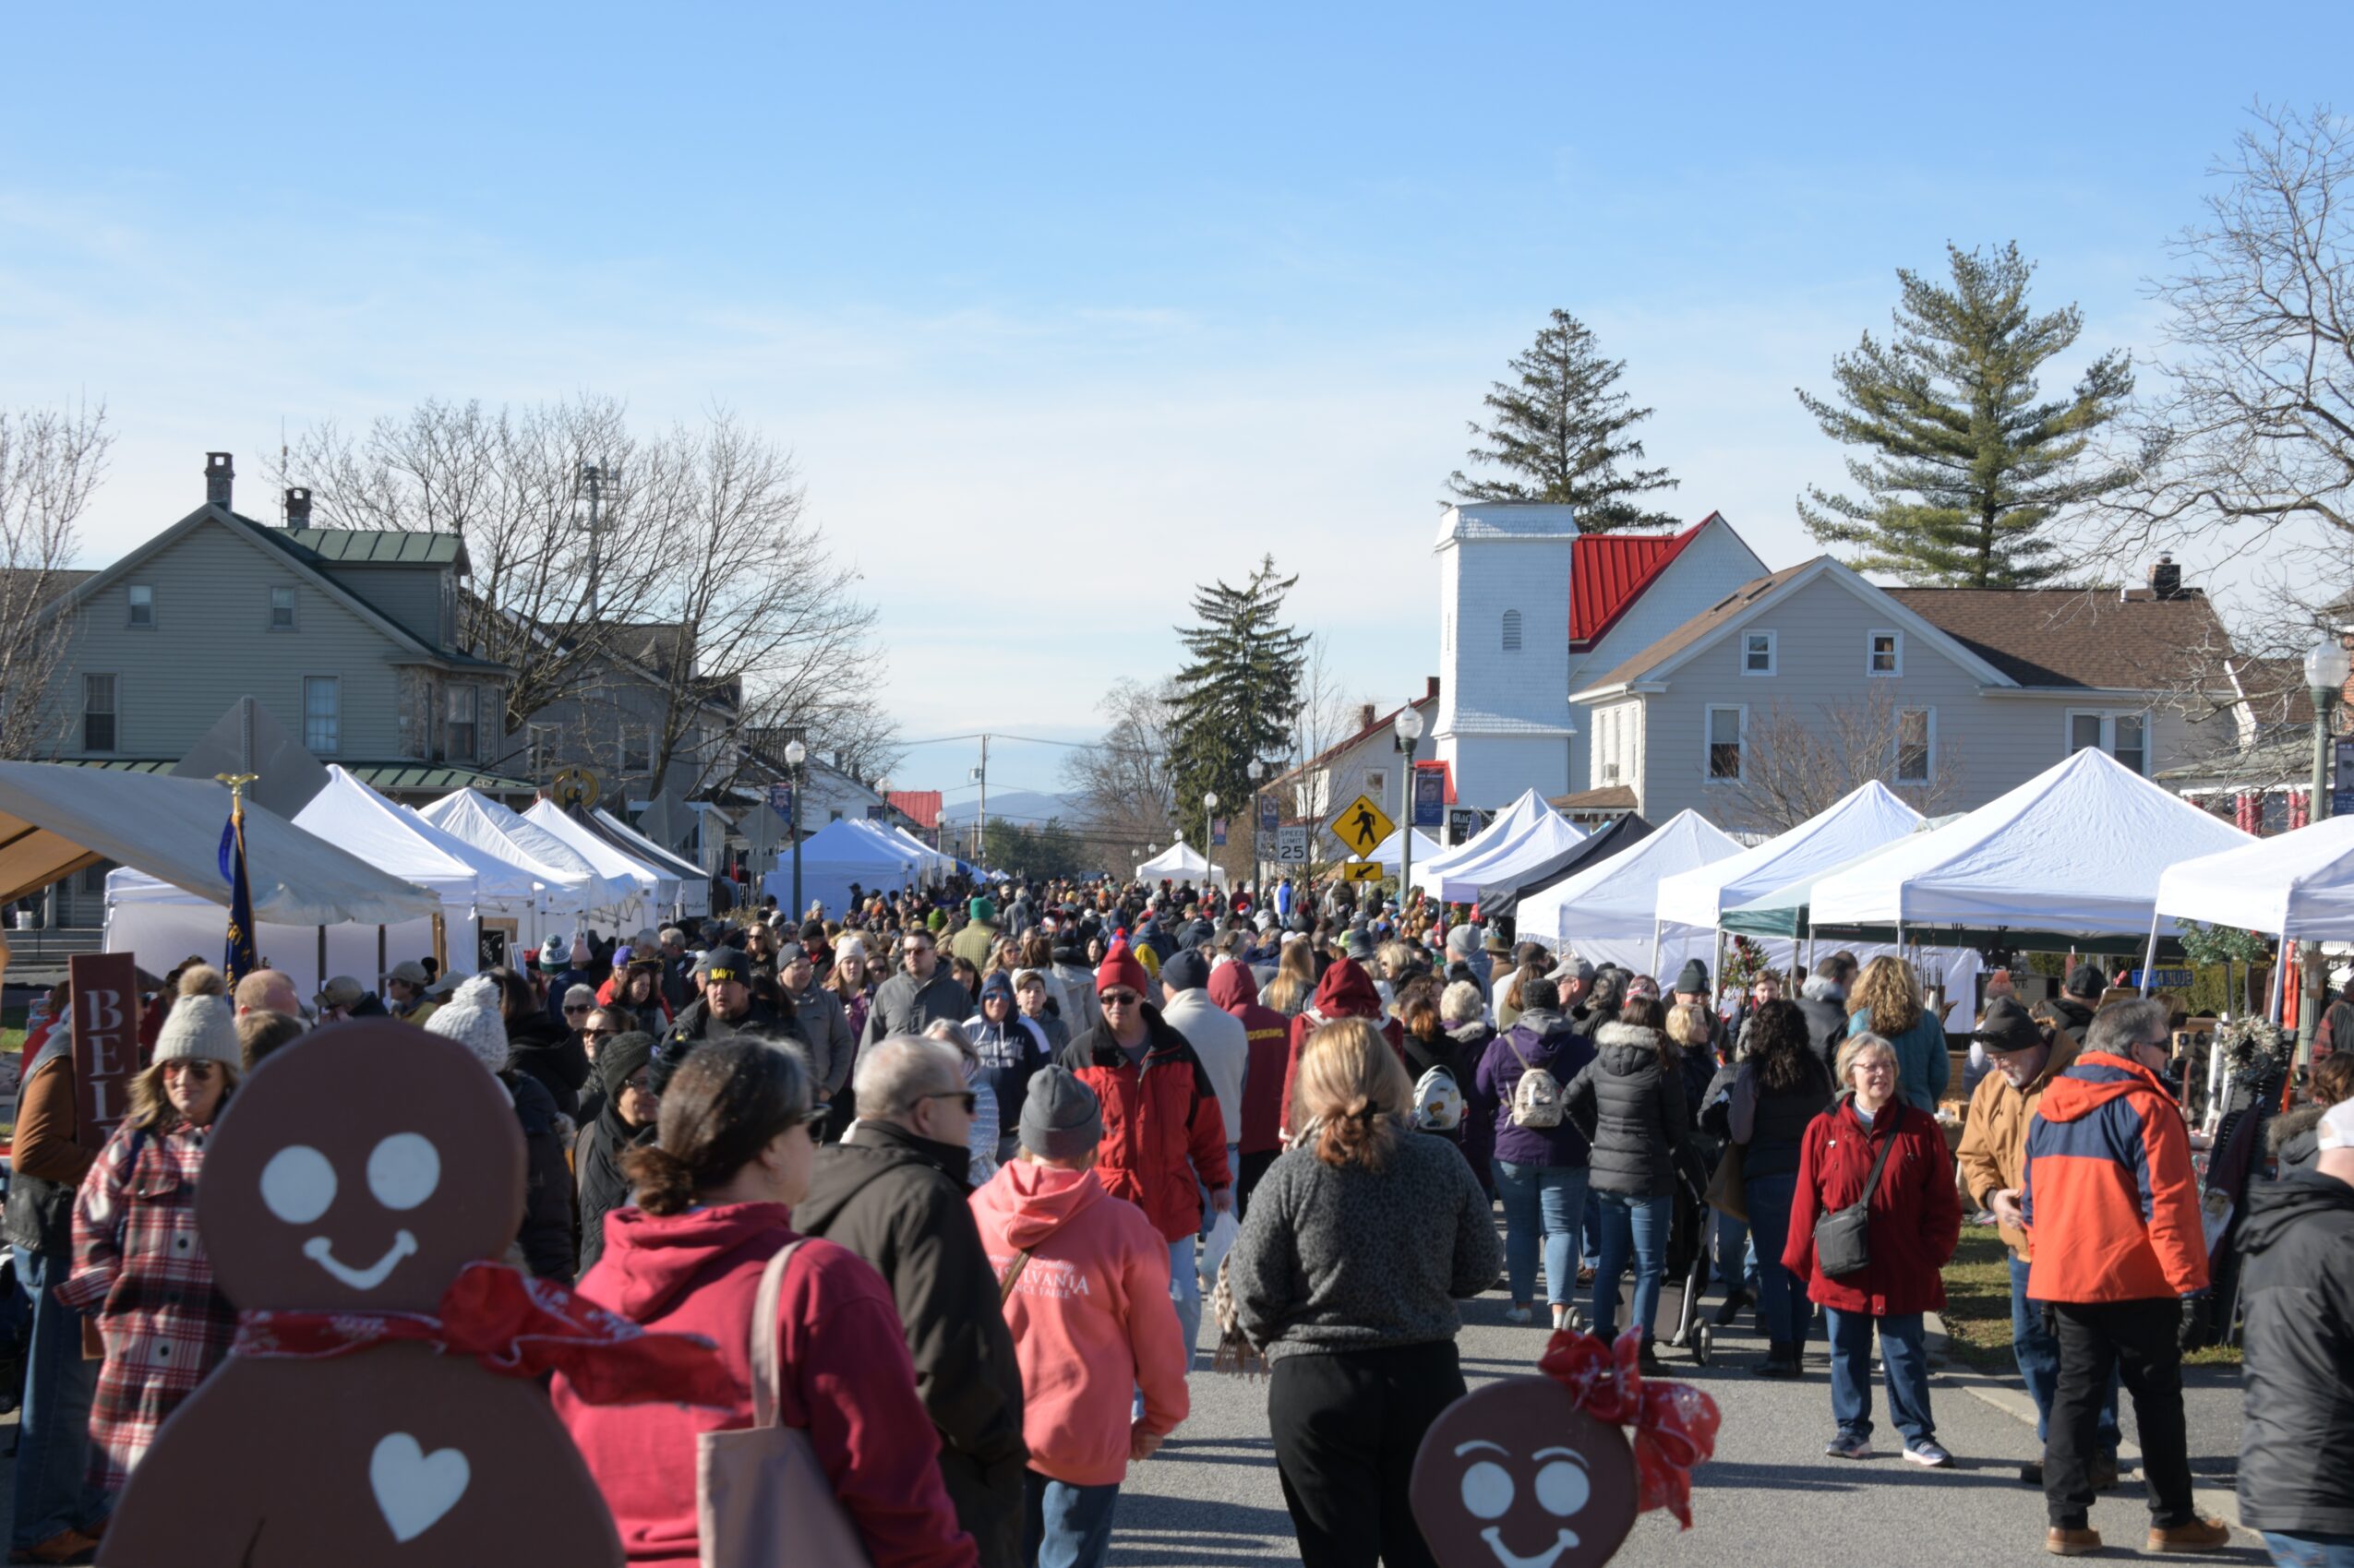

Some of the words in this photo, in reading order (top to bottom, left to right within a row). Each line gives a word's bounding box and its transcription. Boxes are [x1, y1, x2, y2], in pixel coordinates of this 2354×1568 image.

[1280, 845, 1304, 859] 25
[711, 967, 736, 980] NAVY
[1039, 1287, 1070, 1299] FAIRE
